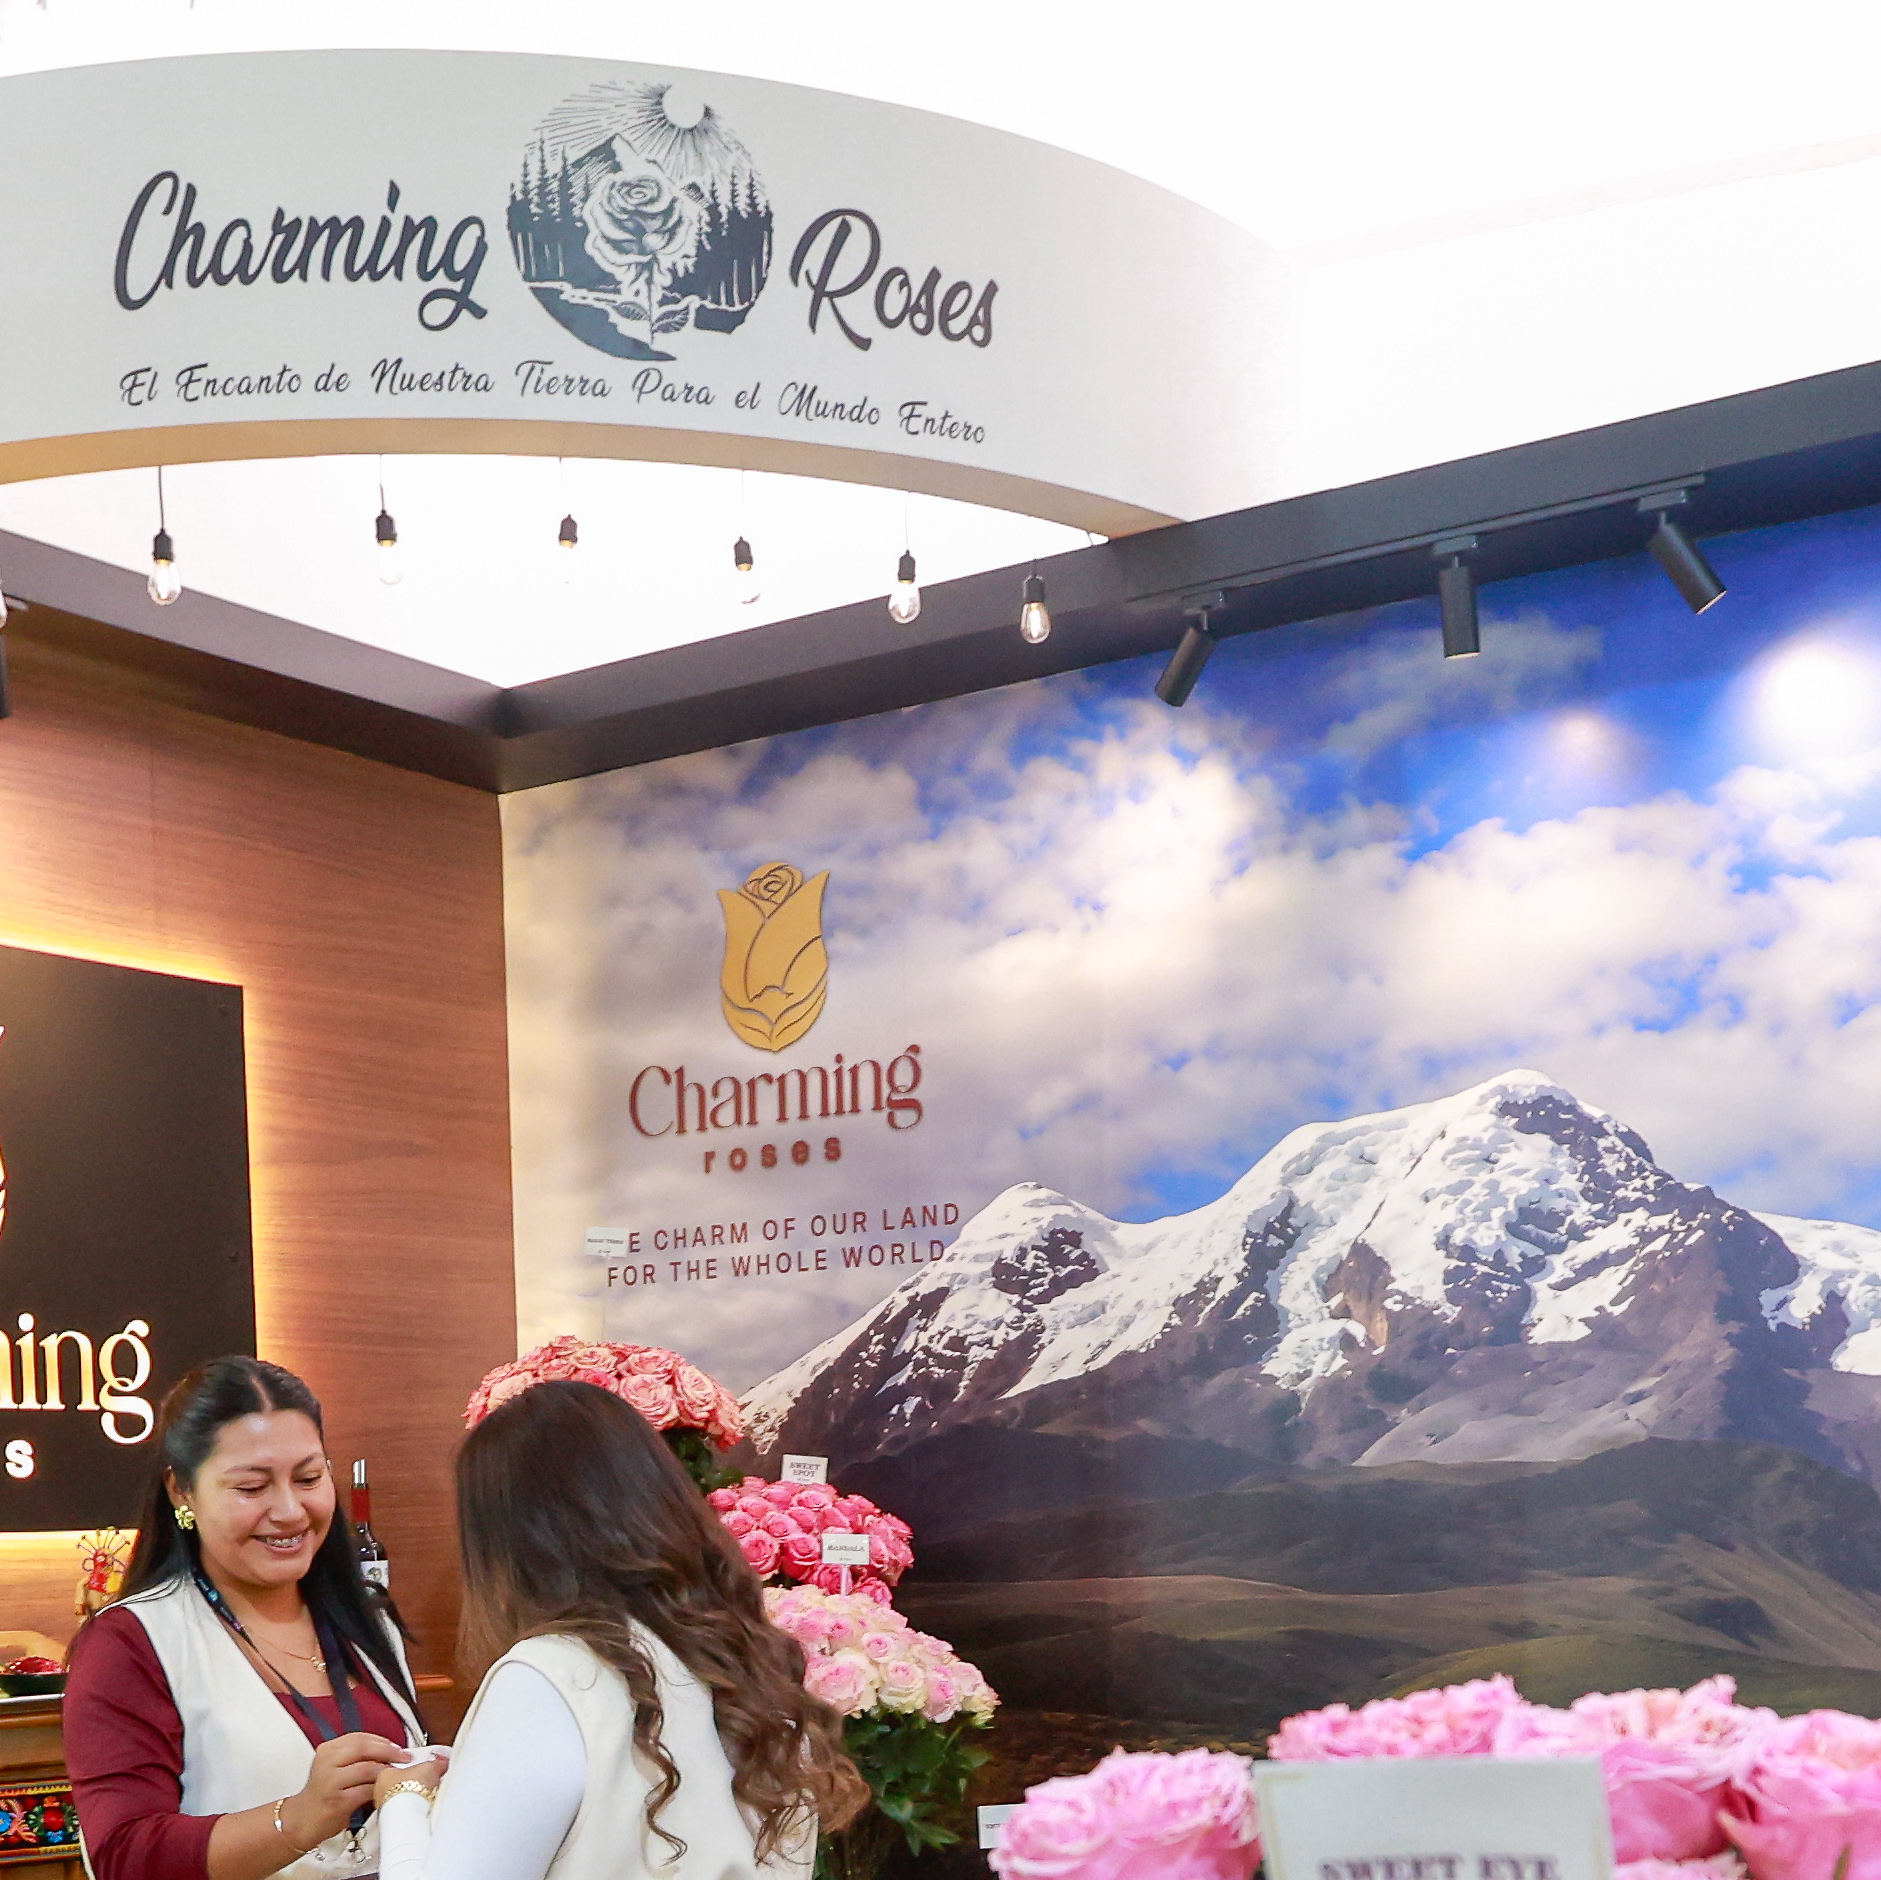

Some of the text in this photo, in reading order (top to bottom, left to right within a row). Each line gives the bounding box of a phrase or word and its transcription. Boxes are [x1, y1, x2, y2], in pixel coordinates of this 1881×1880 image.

[112, 170, 1000, 353] Charming Roses
[120, 357, 987, 446] El Encanto de Nuestra Tierra Para el Mundo Entero
[628, 1044, 924, 1138] Charming
[704, 1137, 843, 1174] roses
[654, 1221, 749, 1252] CHARM
[763, 1217, 796, 1241] OF
[810, 1211, 868, 1238] OUR
[883, 1203, 960, 1231] LAND
[607, 1239, 946, 1287] FOR THE WHOLE WORLD
